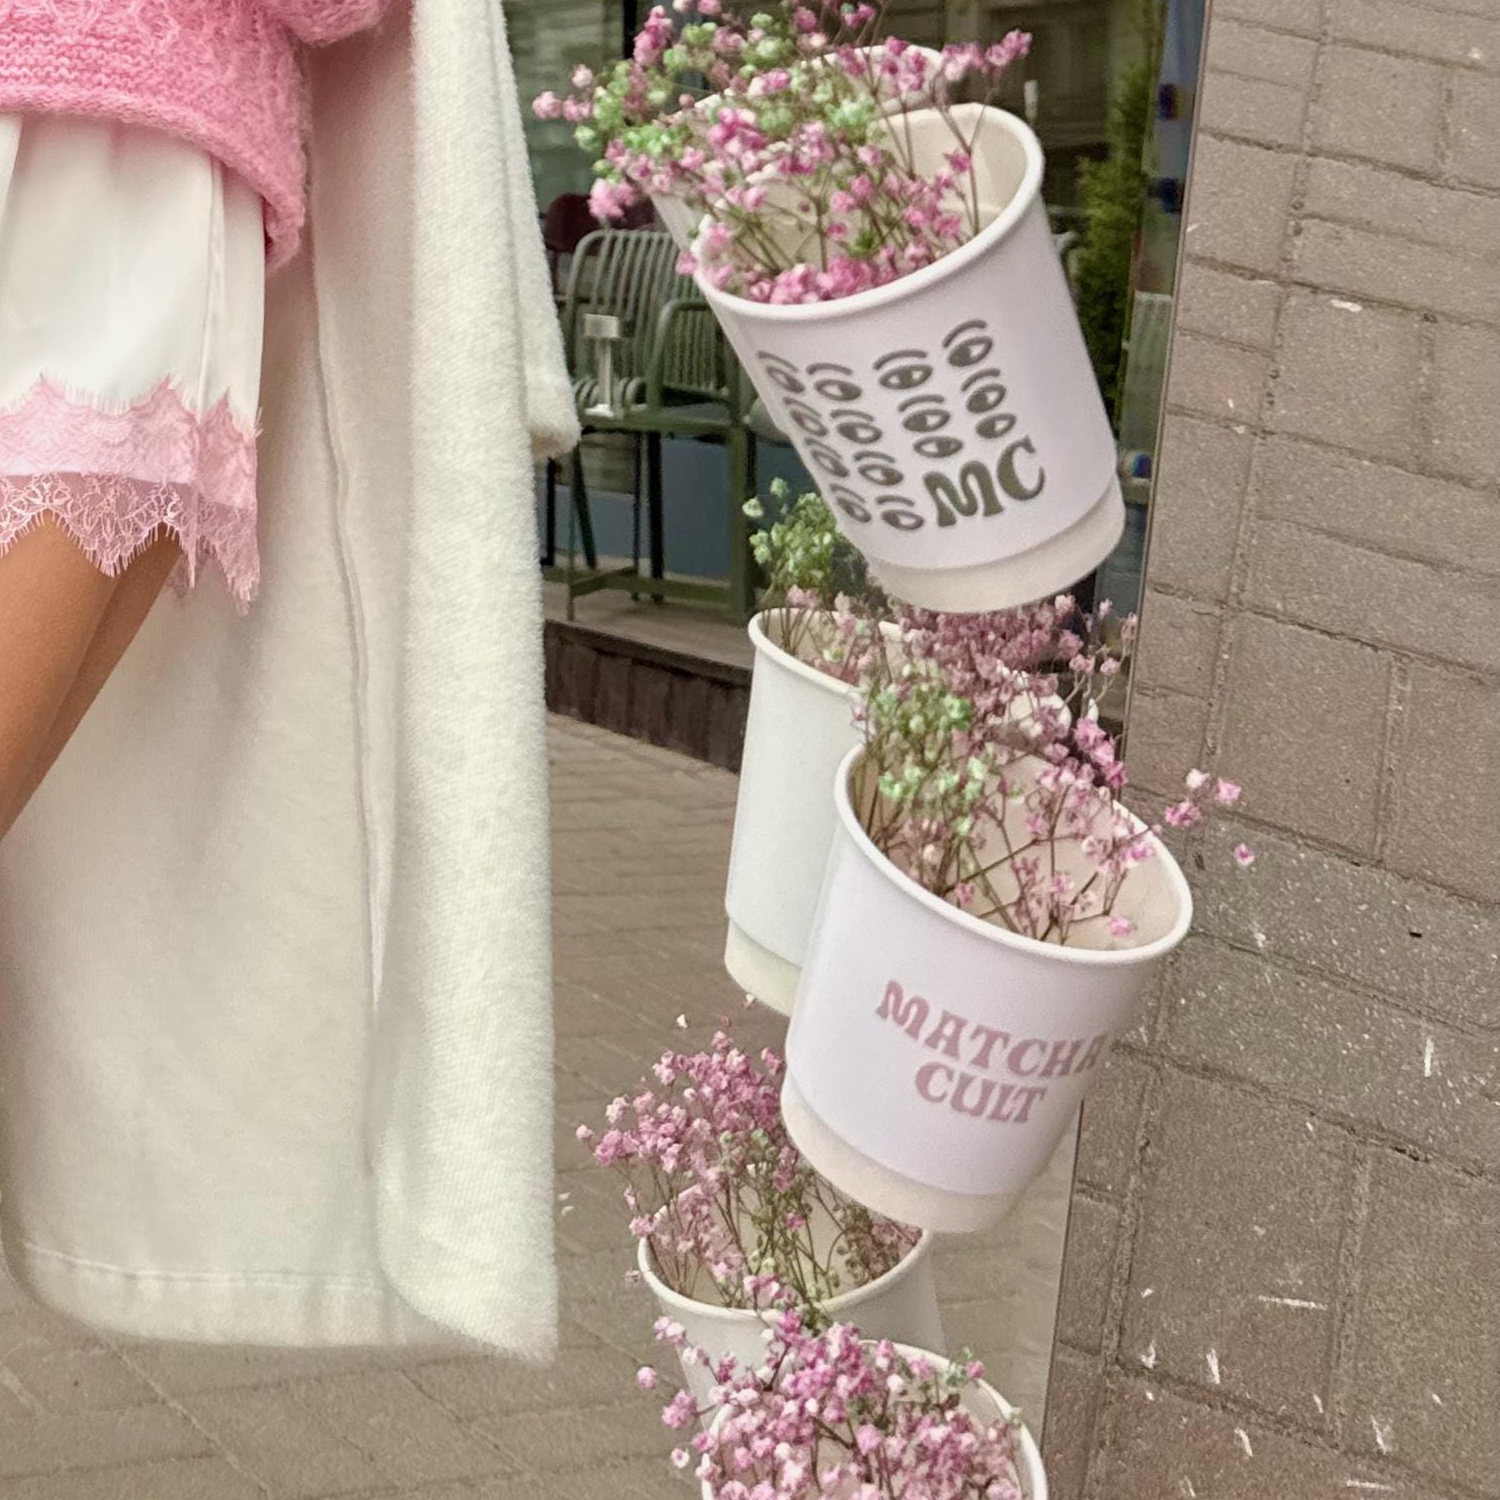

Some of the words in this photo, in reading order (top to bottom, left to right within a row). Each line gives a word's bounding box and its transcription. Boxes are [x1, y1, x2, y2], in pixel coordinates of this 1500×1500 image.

[922, 434, 1045, 527] MC
[875, 979, 1111, 1078] MATCHA
[914, 1061, 1047, 1124] CULT
